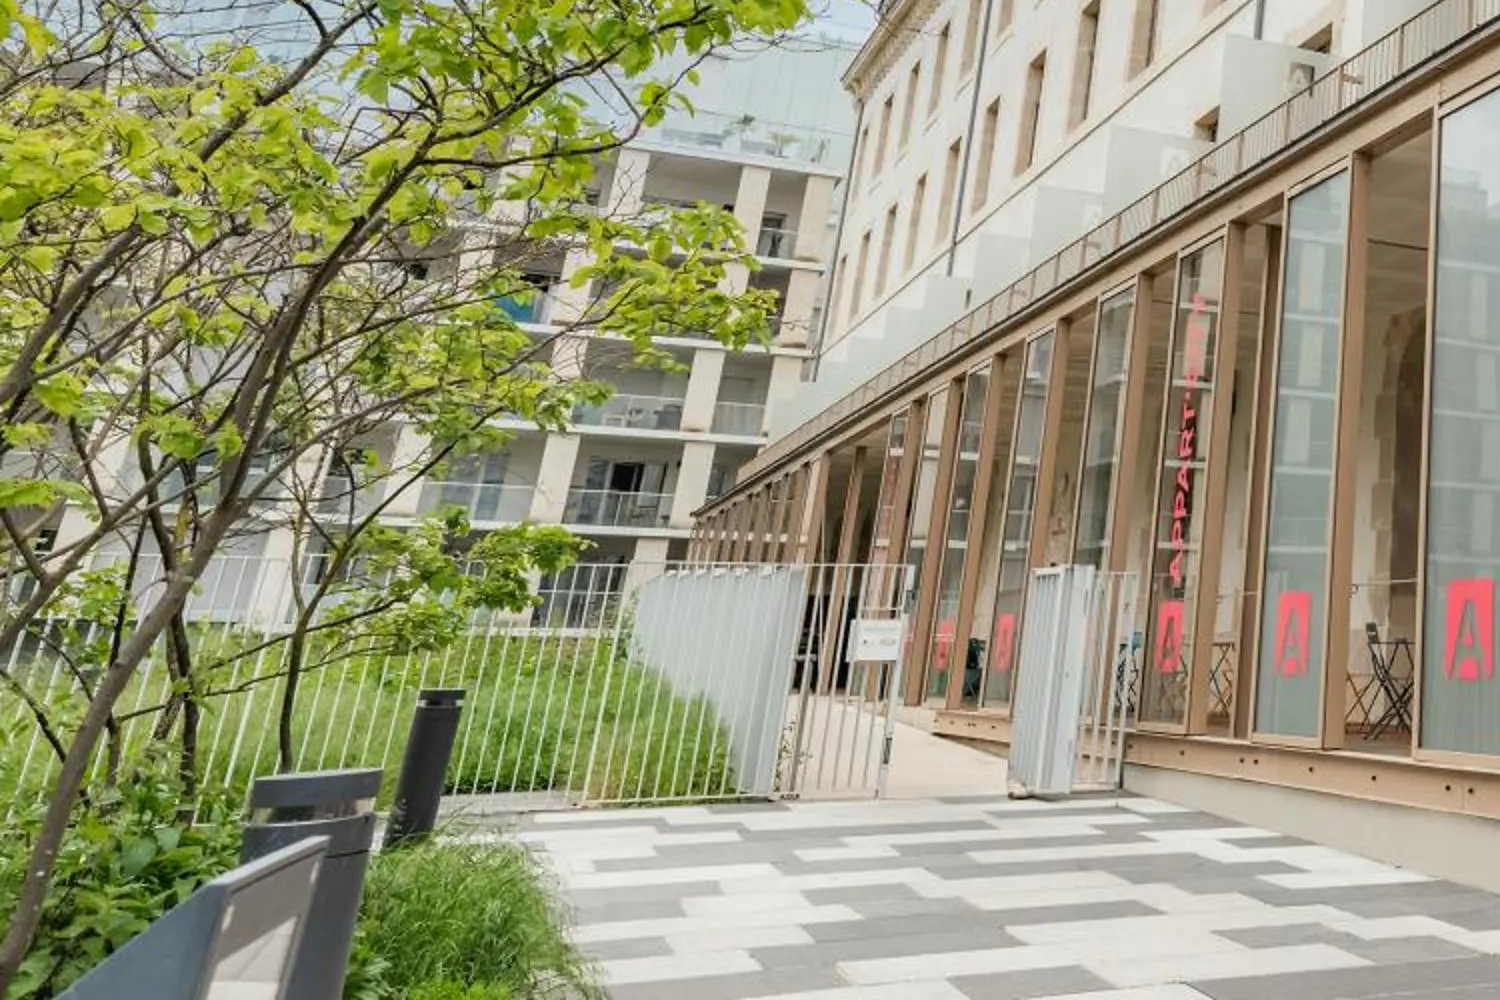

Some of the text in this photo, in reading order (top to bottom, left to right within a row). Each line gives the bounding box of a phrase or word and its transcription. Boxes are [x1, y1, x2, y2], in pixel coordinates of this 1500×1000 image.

[1169, 292, 1206, 589] APPART'
[1275, 594, 1311, 678] A
[1446, 584, 1494, 684] A
